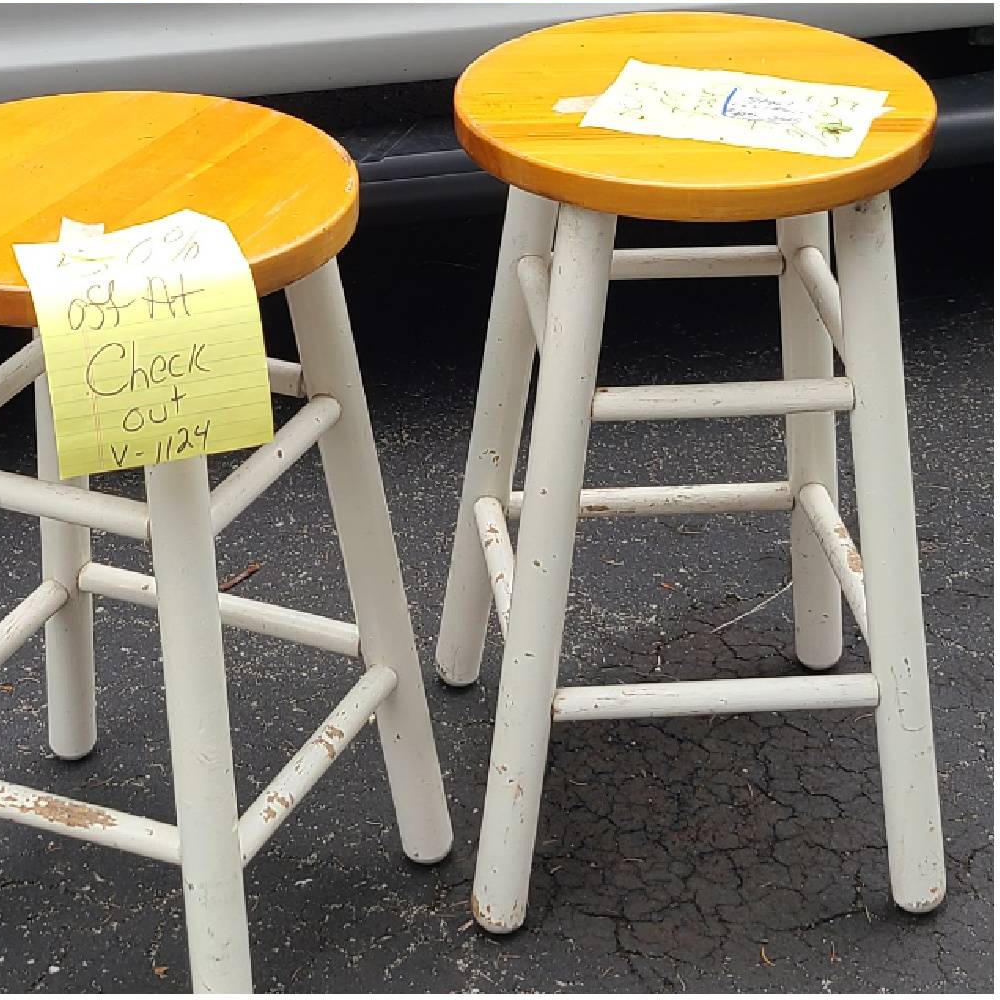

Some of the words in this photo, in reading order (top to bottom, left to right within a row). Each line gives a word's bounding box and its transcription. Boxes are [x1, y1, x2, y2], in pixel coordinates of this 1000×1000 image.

[86, 340, 211, 397] Check
[122, 384, 187, 433] out
[110, 420, 211, 468] V-1124
